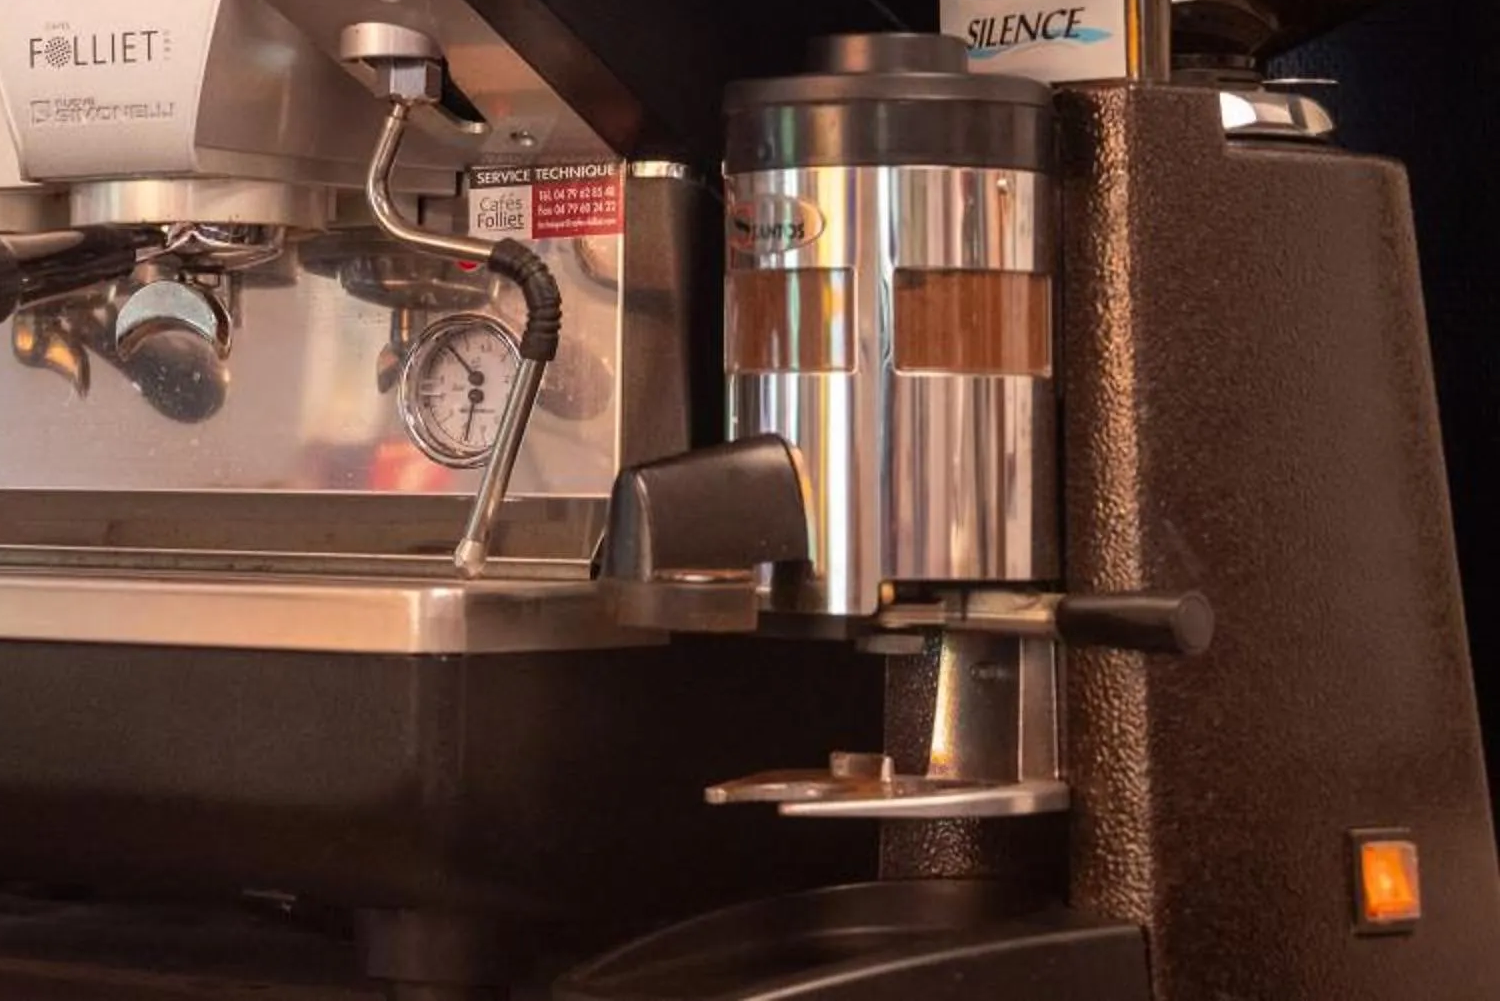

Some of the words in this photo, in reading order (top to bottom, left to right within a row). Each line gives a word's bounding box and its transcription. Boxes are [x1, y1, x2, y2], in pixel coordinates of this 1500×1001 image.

[966, 6, 1086, 50] SILENCE
[477, 169, 531, 185] SERVICE
[535, 163, 615, 181] TECHNIQUE
[479, 193, 524, 212] Cafés
[476, 214, 526, 230] Folliet
